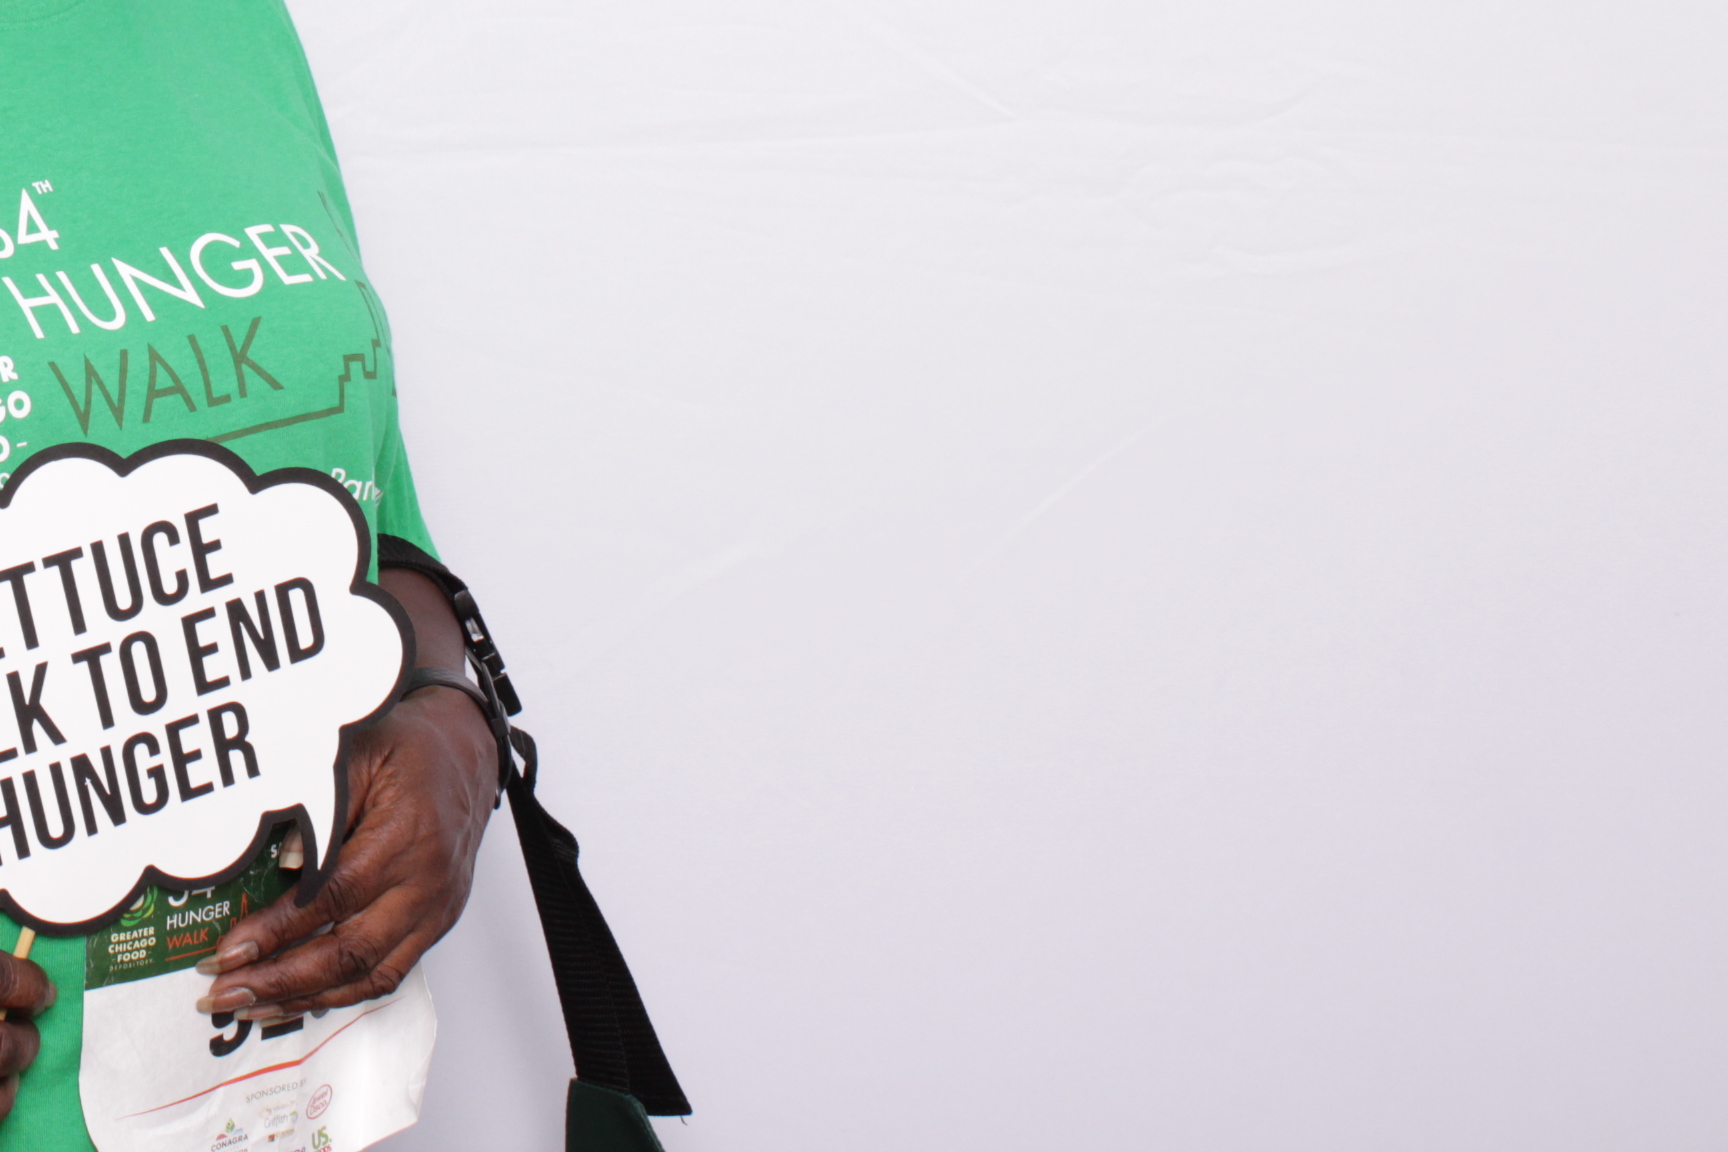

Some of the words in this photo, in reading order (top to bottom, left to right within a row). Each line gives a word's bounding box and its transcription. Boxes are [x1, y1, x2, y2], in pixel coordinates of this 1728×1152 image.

[1, 223, 347, 340] HUNGER
[48, 316, 284, 438] WALK
[71, 631, 168, 730] TO
[181, 577, 325, 696] END
[166, 900, 231, 930] HUNGER
[108, 936, 157, 954] CHICAGO
[110, 926, 155, 943] GREATER
[166, 927, 209, 949] WALK
[246, 1081, 298, 1103] SPONSORED
[210, 1133, 249, 1152] CONAGRA
